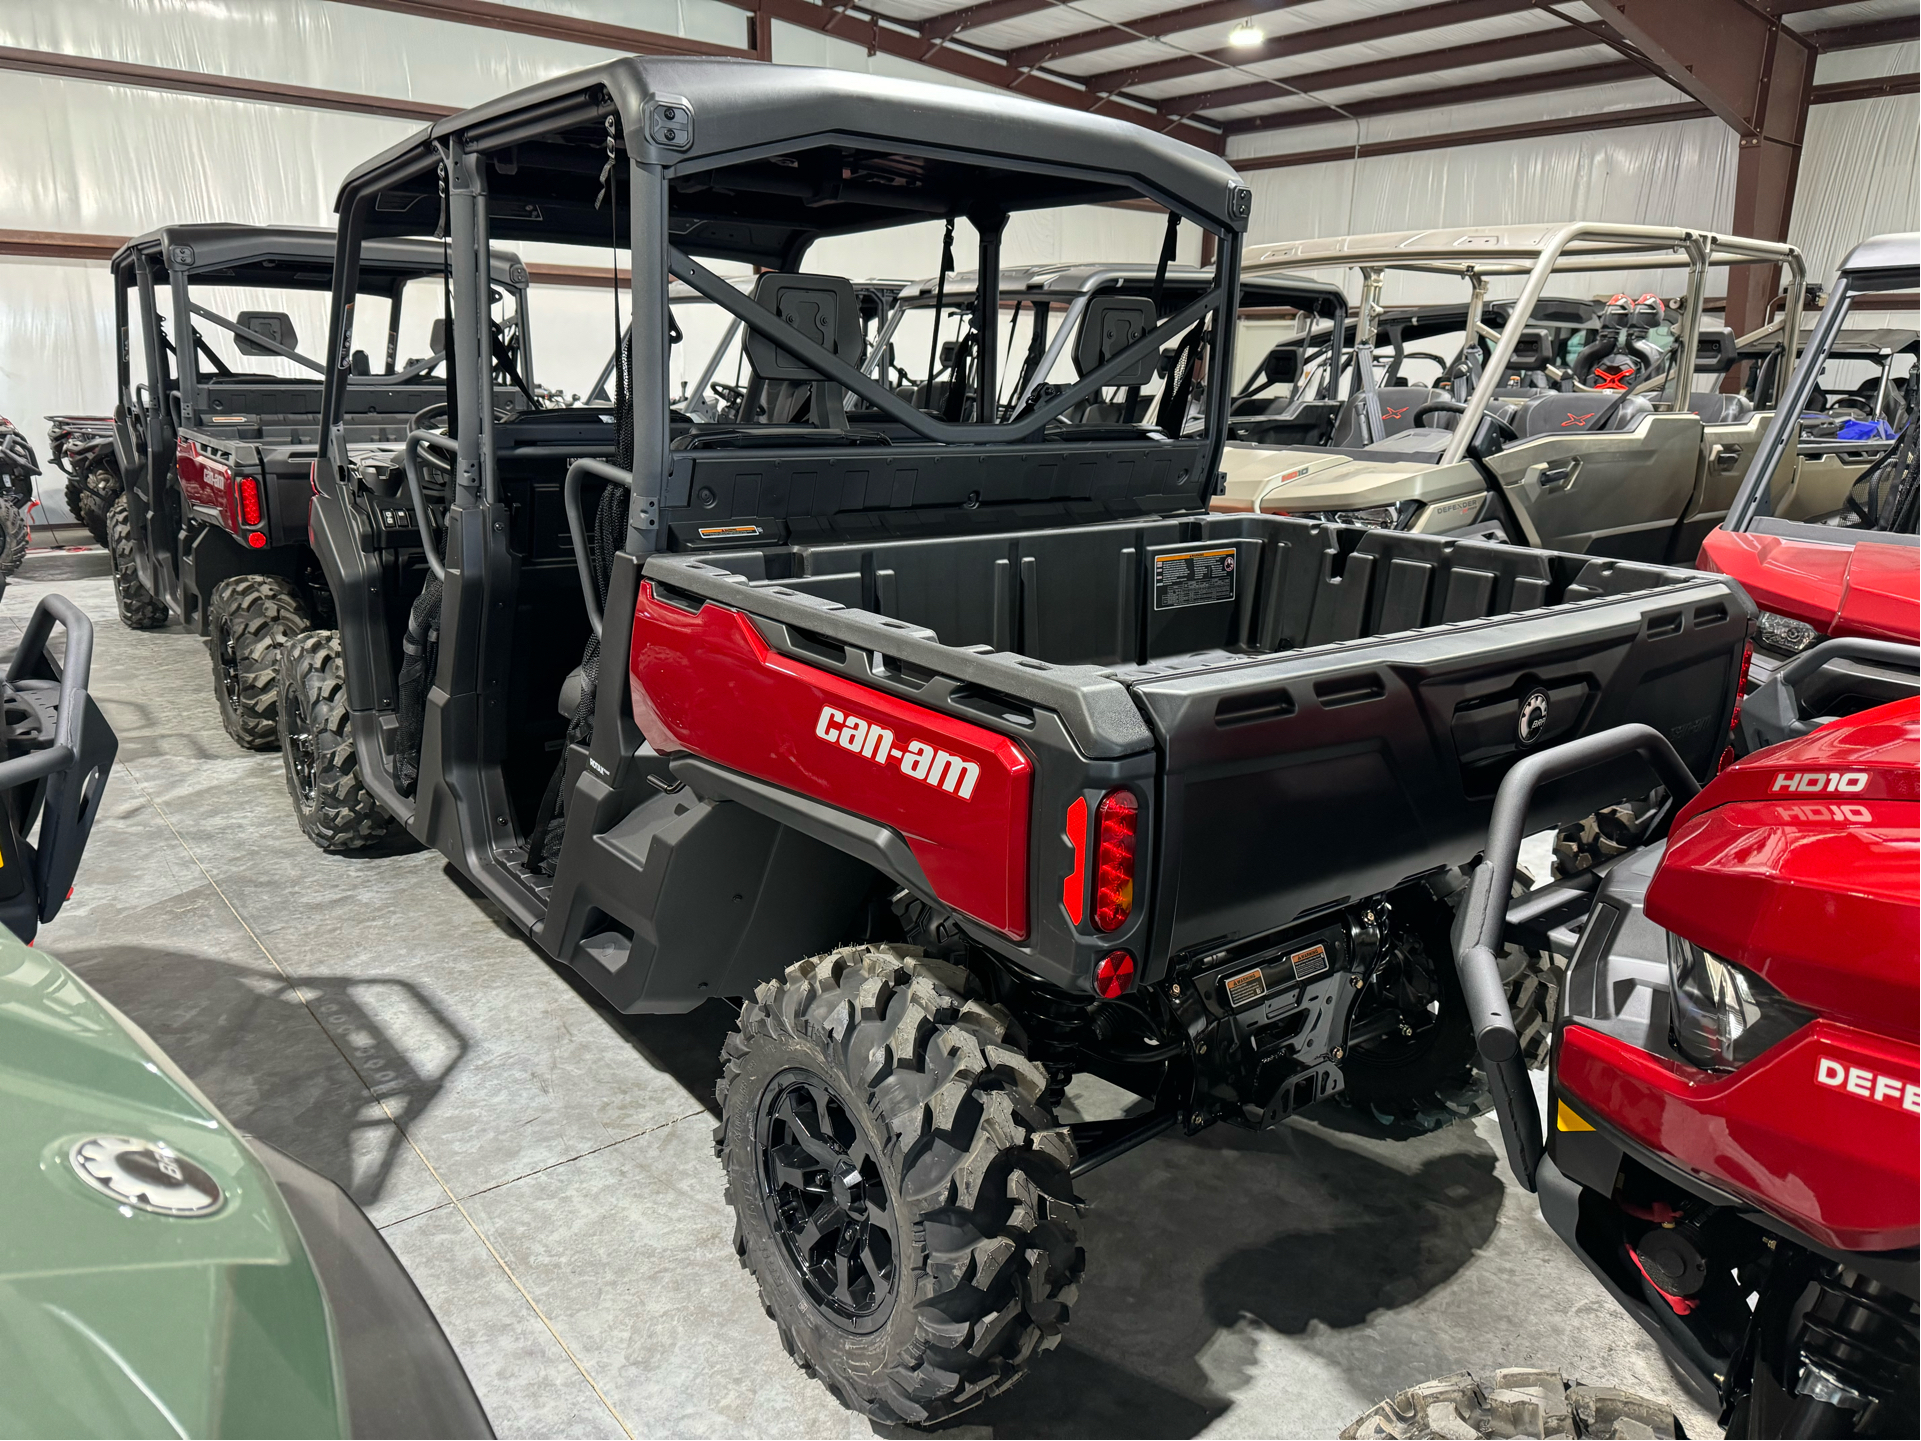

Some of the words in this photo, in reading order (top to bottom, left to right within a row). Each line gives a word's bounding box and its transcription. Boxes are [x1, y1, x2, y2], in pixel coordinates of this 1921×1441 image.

[816, 706, 980, 799] can-am
[1772, 773, 1868, 792] HD10
[1301, 949, 1319, 960] WARNING
[1238, 974, 1256, 984] WARNING
[1817, 1058, 1920, 1113] DEFE
